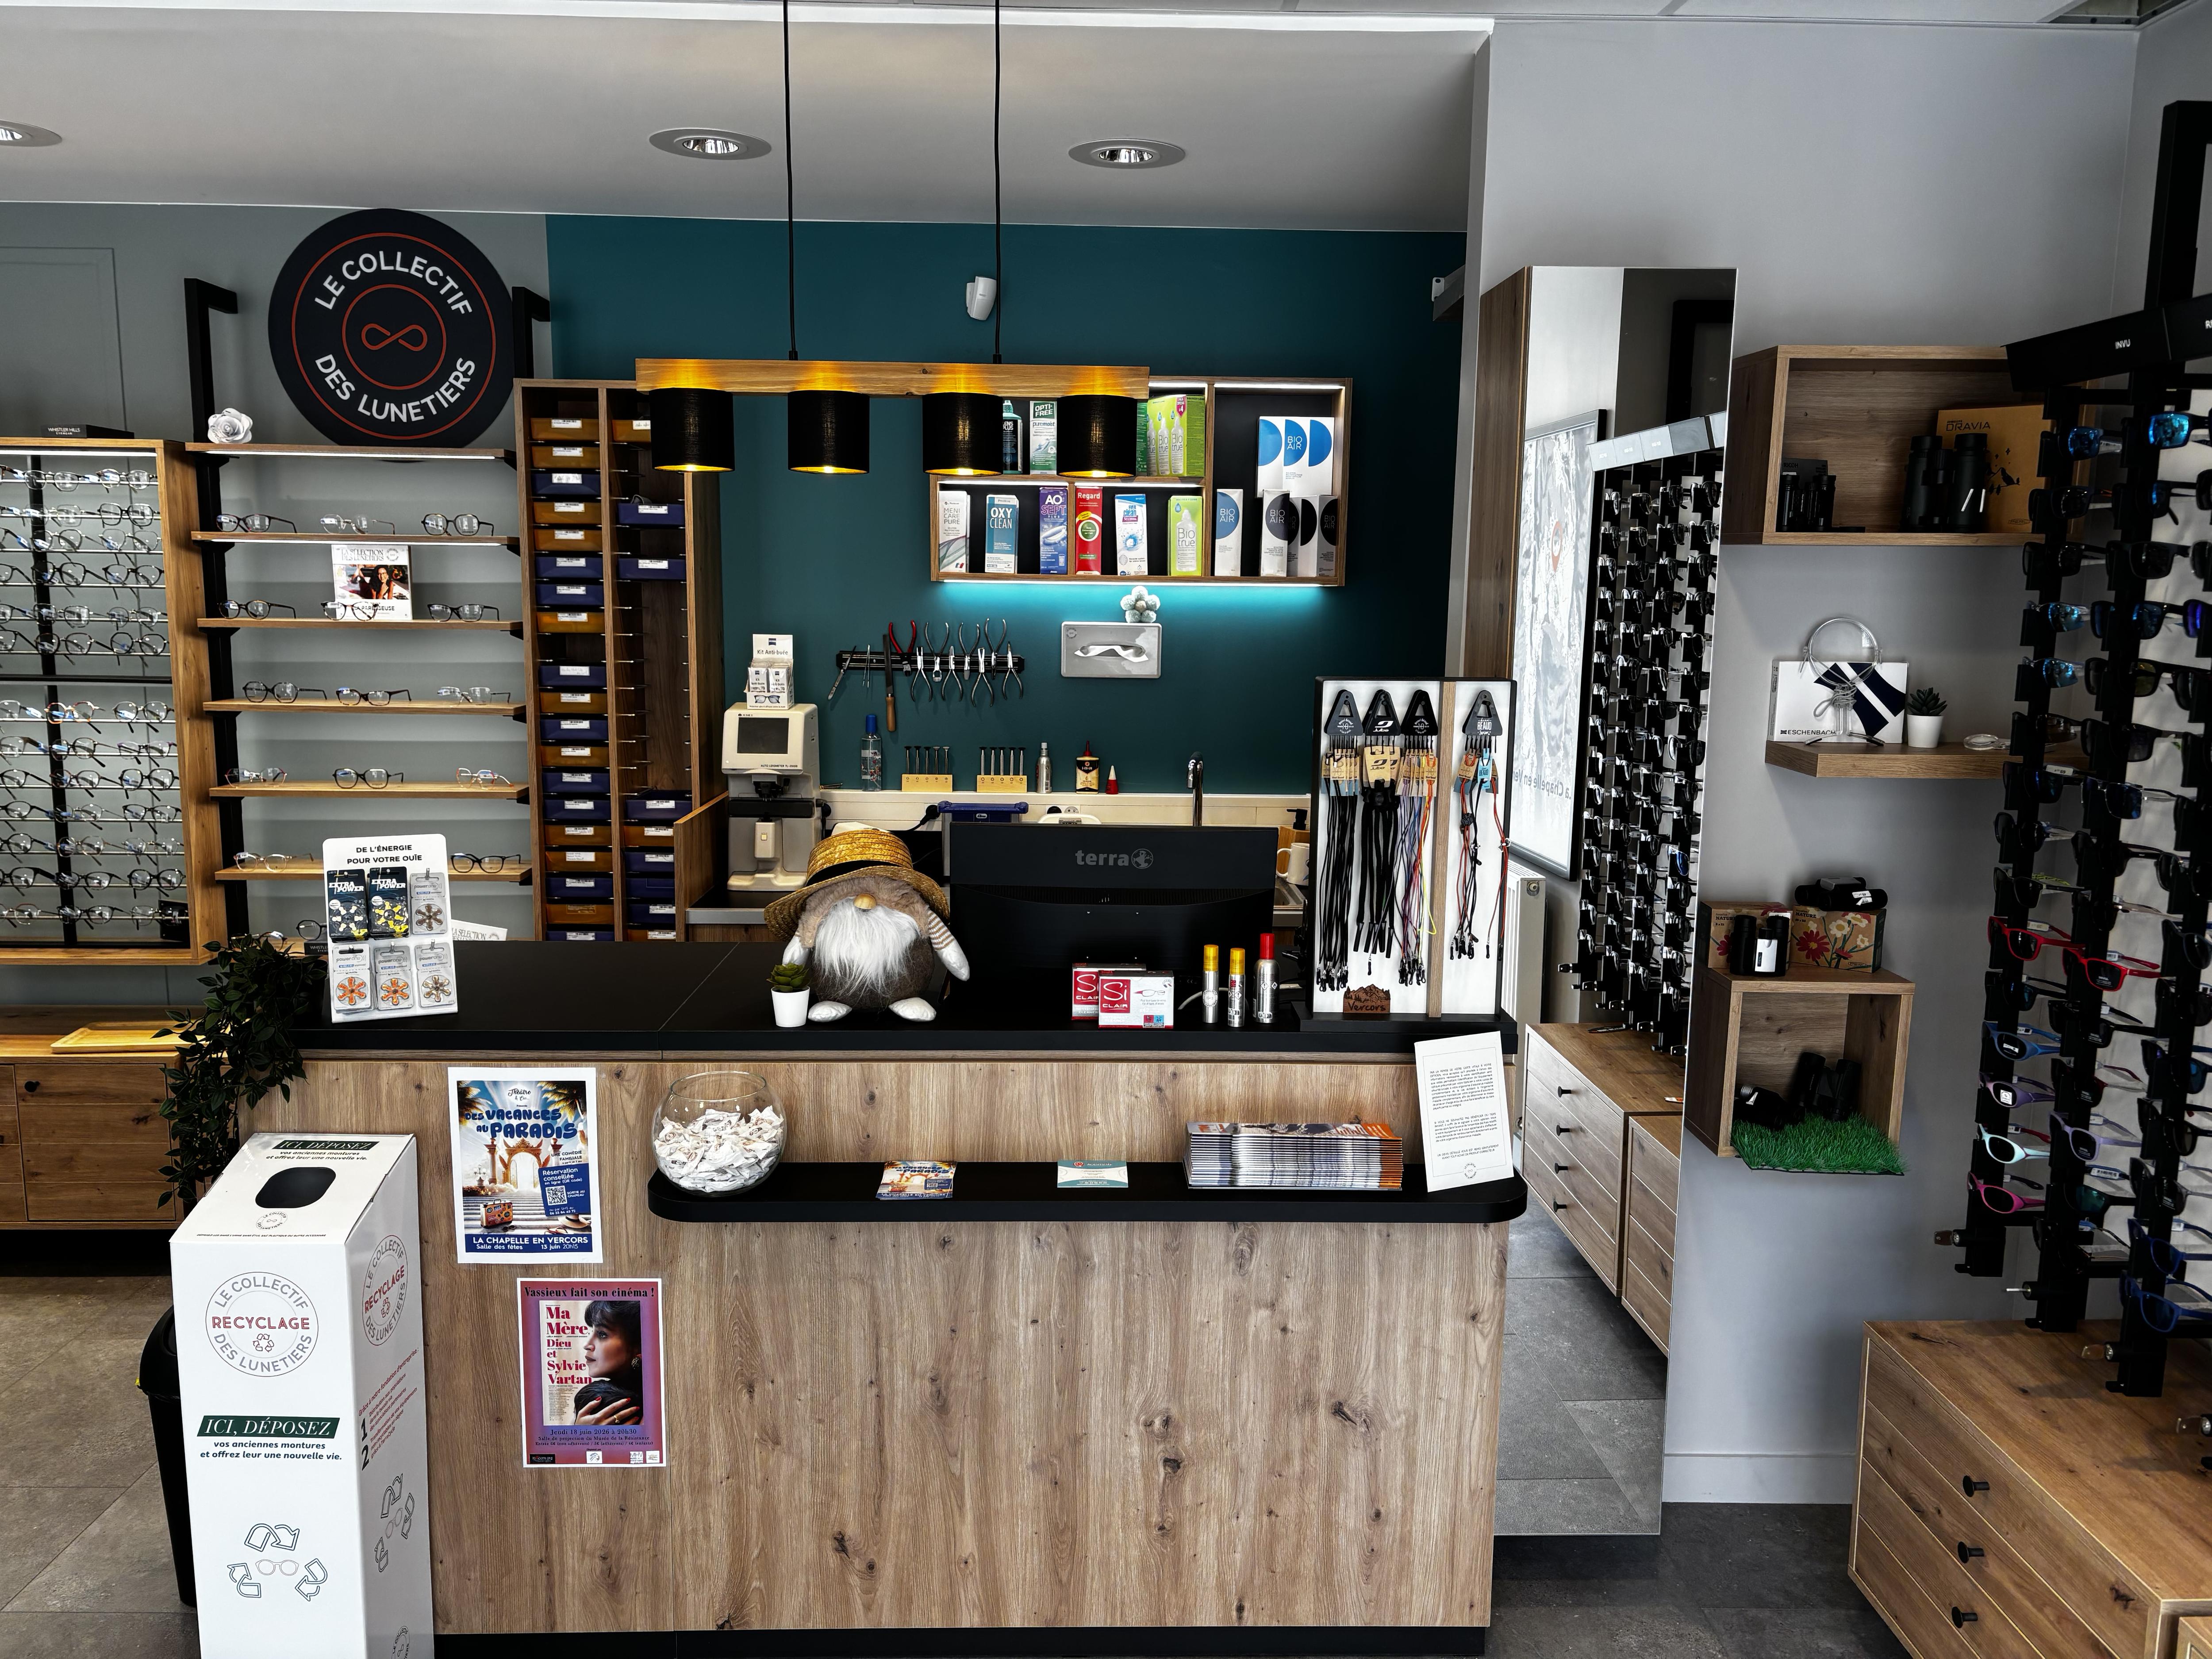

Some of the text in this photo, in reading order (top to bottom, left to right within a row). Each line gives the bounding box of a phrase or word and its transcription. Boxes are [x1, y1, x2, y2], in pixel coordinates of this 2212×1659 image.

[315, 250, 472, 314] LE COLLECTIF
[2115, 339, 2131, 349] INVU
[315, 354, 476, 422] DES LUNETIERS
[1045, 495, 1063, 505] AO
[991, 507, 1013, 518] OXY
[1041, 505, 1066, 515] SEPT
[990, 518, 1012, 529] CLEAN
[1178, 528, 1195, 539] Bio
[1477, 721, 1492, 731] BEAUD
[1075, 850, 1129, 867] terra
[1103, 982, 1127, 1001] Si
[1348, 1002, 1386, 1012] Vercors
[465, 1108, 562, 1121] DES VACANCES
[476, 1122, 577, 1139] AU PARADIS
[306, 1140, 372, 1149] DÉPOSEZ
[366, 1239, 404, 1289] LE COLLECTIF
[215, 1276, 308, 1310] LE COLLECTIF
[365, 1264, 404, 1314] RECYCLAGE
[524, 1286, 654, 1297] Vassieux fait son cinéma !
[365, 1282, 405, 1341] DES LUNETIERS
[546, 1306, 571, 1319] Ma
[212, 1316, 310, 1330] RECYCLAGE
[547, 1339, 572, 1348] Dieu
[214, 1333, 312, 1373] DES LUNETIERS
[547, 1359, 586, 1374] Sylvie
[548, 1374, 592, 1384] Vartan
[204, 1417, 331, 1436] ICI, DÉPOSEZ
[361, 1417, 368, 1442] 1
[361, 1444, 369, 1471] 2
